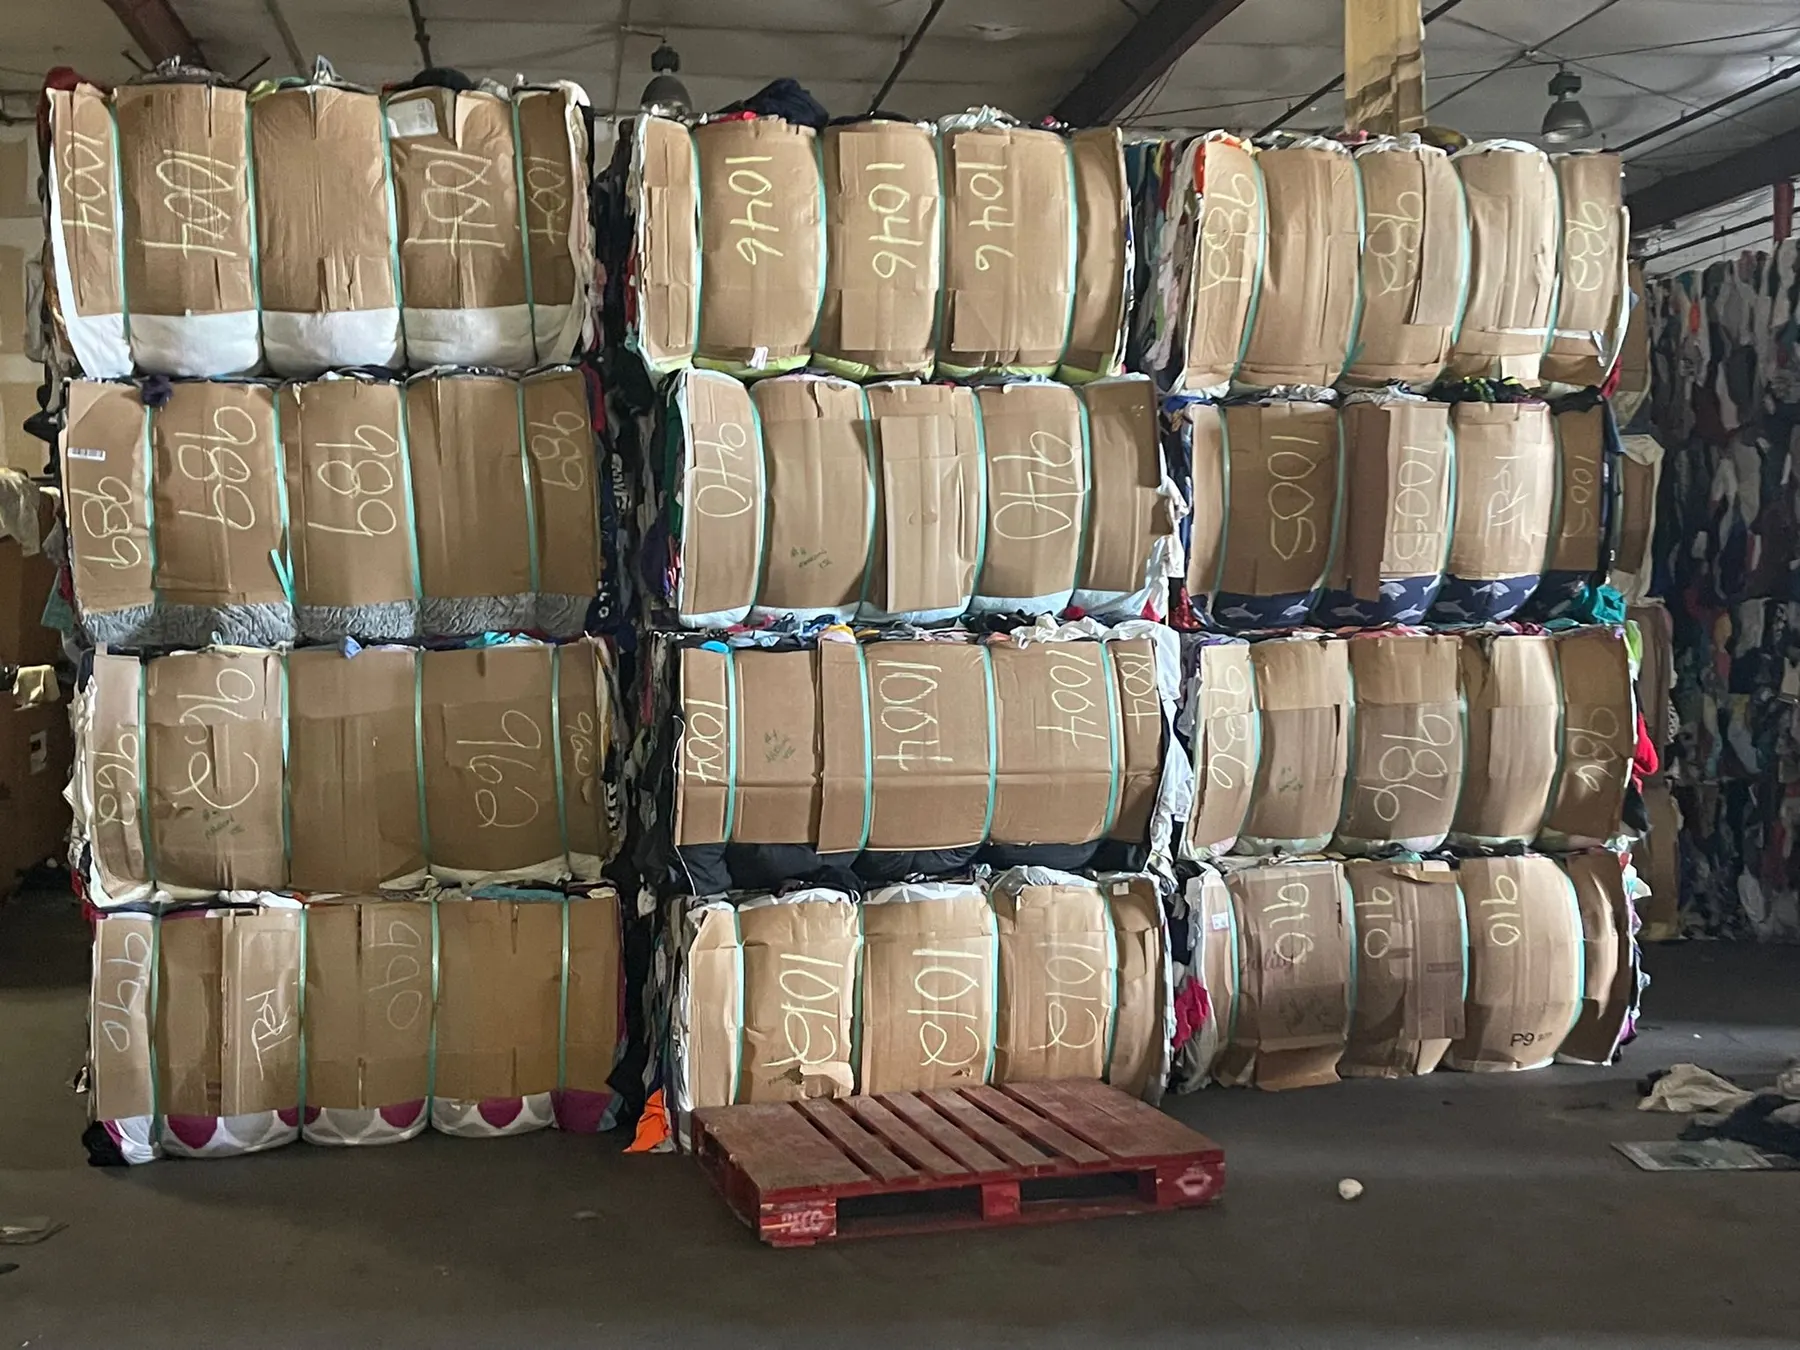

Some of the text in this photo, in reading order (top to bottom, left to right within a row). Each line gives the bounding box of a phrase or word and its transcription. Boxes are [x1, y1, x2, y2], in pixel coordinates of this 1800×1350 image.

[61, 131, 114, 236] 1004
[137, 149, 237, 260] 1004
[404, 144, 505, 259] 1004
[526, 156, 567, 247] 1004
[724, 155, 783, 267] 1046
[865, 162, 924, 279] 1046
[956, 160, 1015, 272] 1046
[1565, 202, 1607, 292] 982
[175, 405, 257, 531] 989
[307, 424, 400, 538] 989
[529, 410, 586, 490] 989
[693, 422, 752, 518] 940
[992, 430, 1084, 541] 940
[1266, 434, 1321, 561] 1005
[1392, 445, 1439, 560] 1005
[70, 476, 142, 569] 989
[172, 668, 260, 810] 962
[686, 698, 729, 783] 1004
[876, 659, 954, 772] 1004
[1036, 649, 1107, 751] 1004
[1567, 707, 1620, 792] 986
[91, 732, 139, 826] 962
[455, 709, 542, 829] 962
[1359, 713, 1454, 822] 986
[1262, 882, 1314, 964] 910
[1355, 885, 1393, 959] 910
[1480, 874, 1521, 947] 910
[98, 931, 153, 1053] 990
[368, 920, 422, 1030] 990
[760, 952, 844, 1067] 1012
[907, 948, 984, 1067] 1012
[1029, 941, 1103, 1051] 1012
[1510, 1032, 1535, 1047] P9
